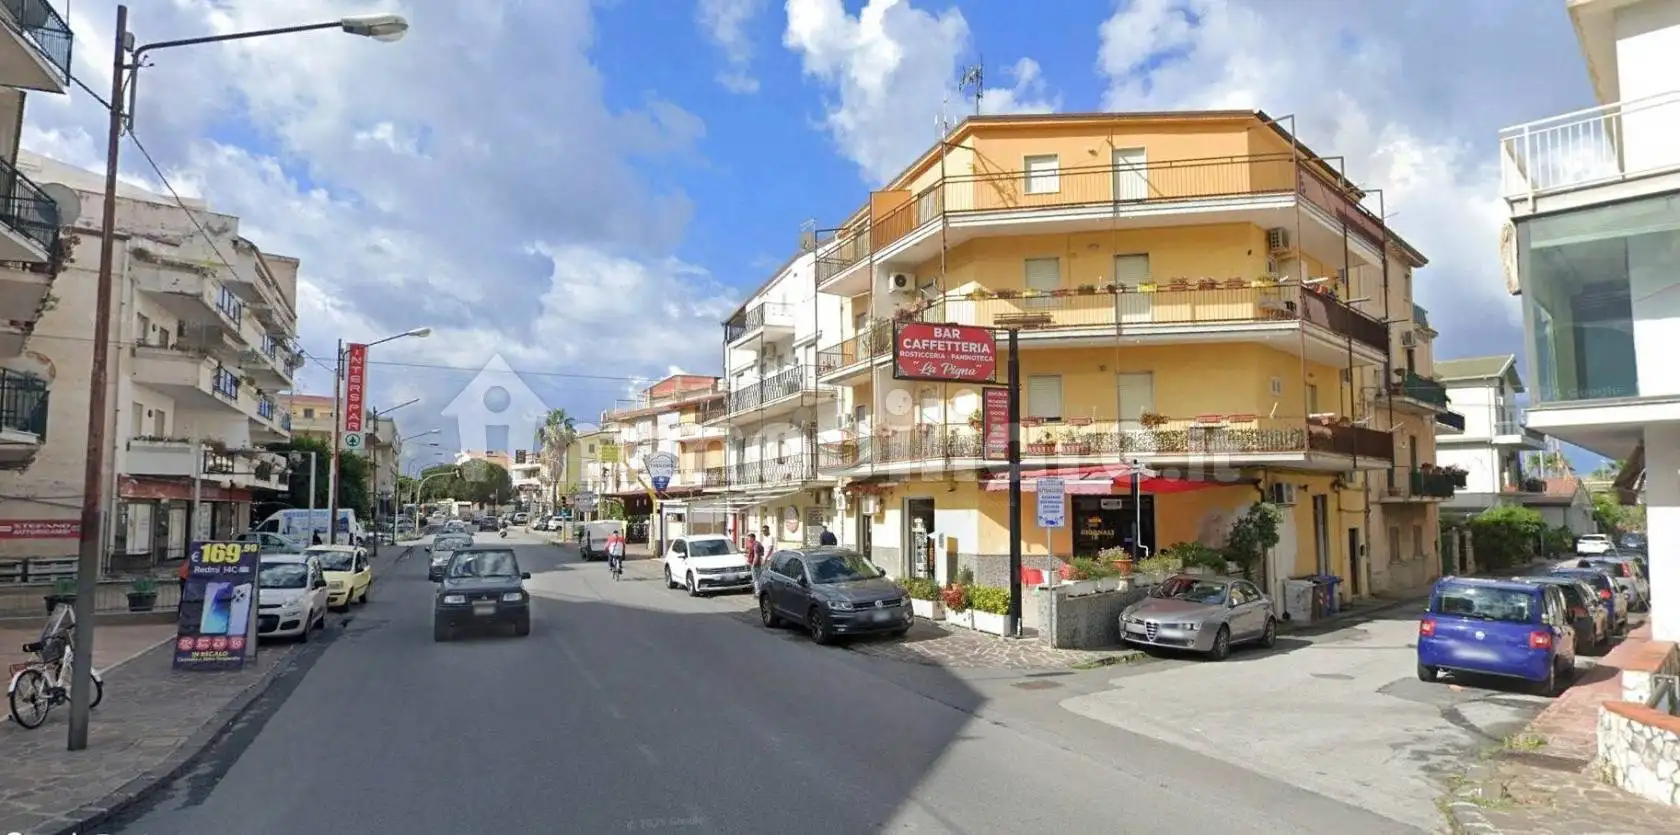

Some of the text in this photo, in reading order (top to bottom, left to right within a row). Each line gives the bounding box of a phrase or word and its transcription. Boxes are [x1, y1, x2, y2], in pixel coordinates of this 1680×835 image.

[933, 327, 960, 339] BAR
[903, 338, 991, 353] CAFFETTERIA
[899, 350, 946, 359] ROSTICCERIA
[951, 353, 993, 362] PANINOTECA
[347, 348, 363, 431] INTERSPAR
[193, 565, 221, 574] Redmi
